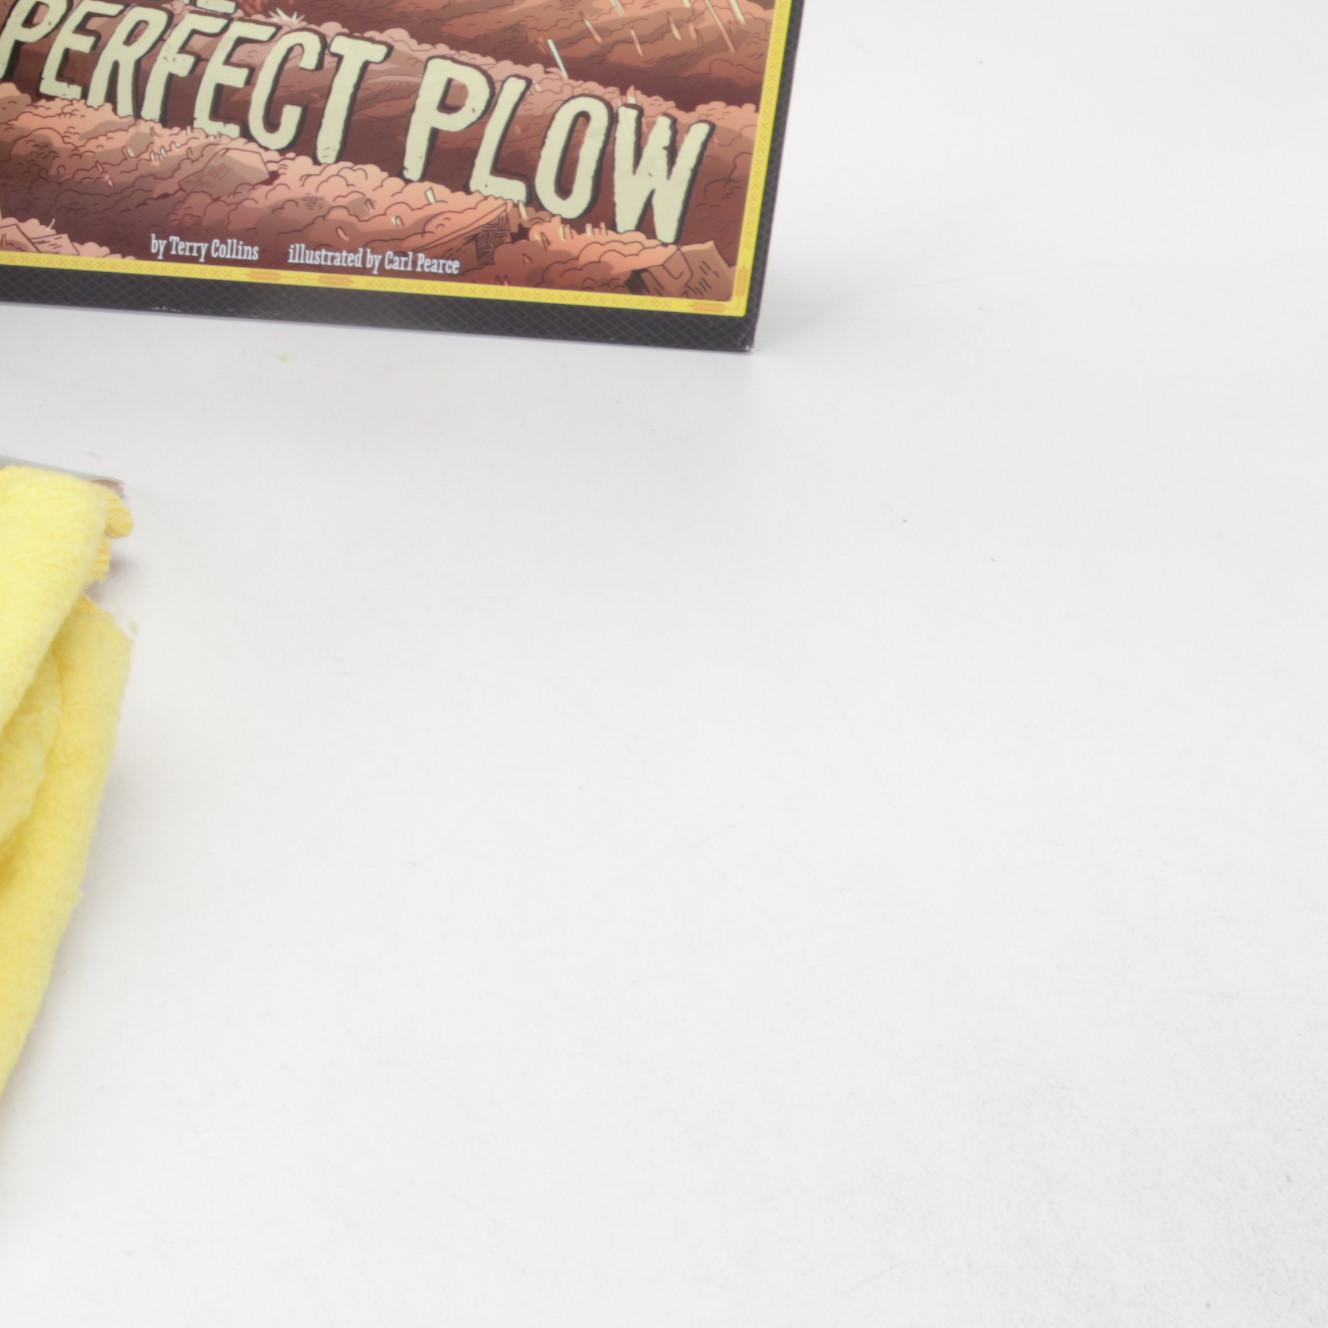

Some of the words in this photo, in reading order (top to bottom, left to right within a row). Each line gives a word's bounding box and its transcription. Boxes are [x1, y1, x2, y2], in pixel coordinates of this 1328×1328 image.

[402, 55, 714, 244] PLOW
[150, 233, 167, 259] by
[169, 235, 207, 262] Terry
[210, 238, 260, 260] Collins
[288, 243, 363, 268] illustrated
[366, 248, 382, 274] by
[384, 250, 413, 271] Carl
[415, 253, 460, 275] Pearce
